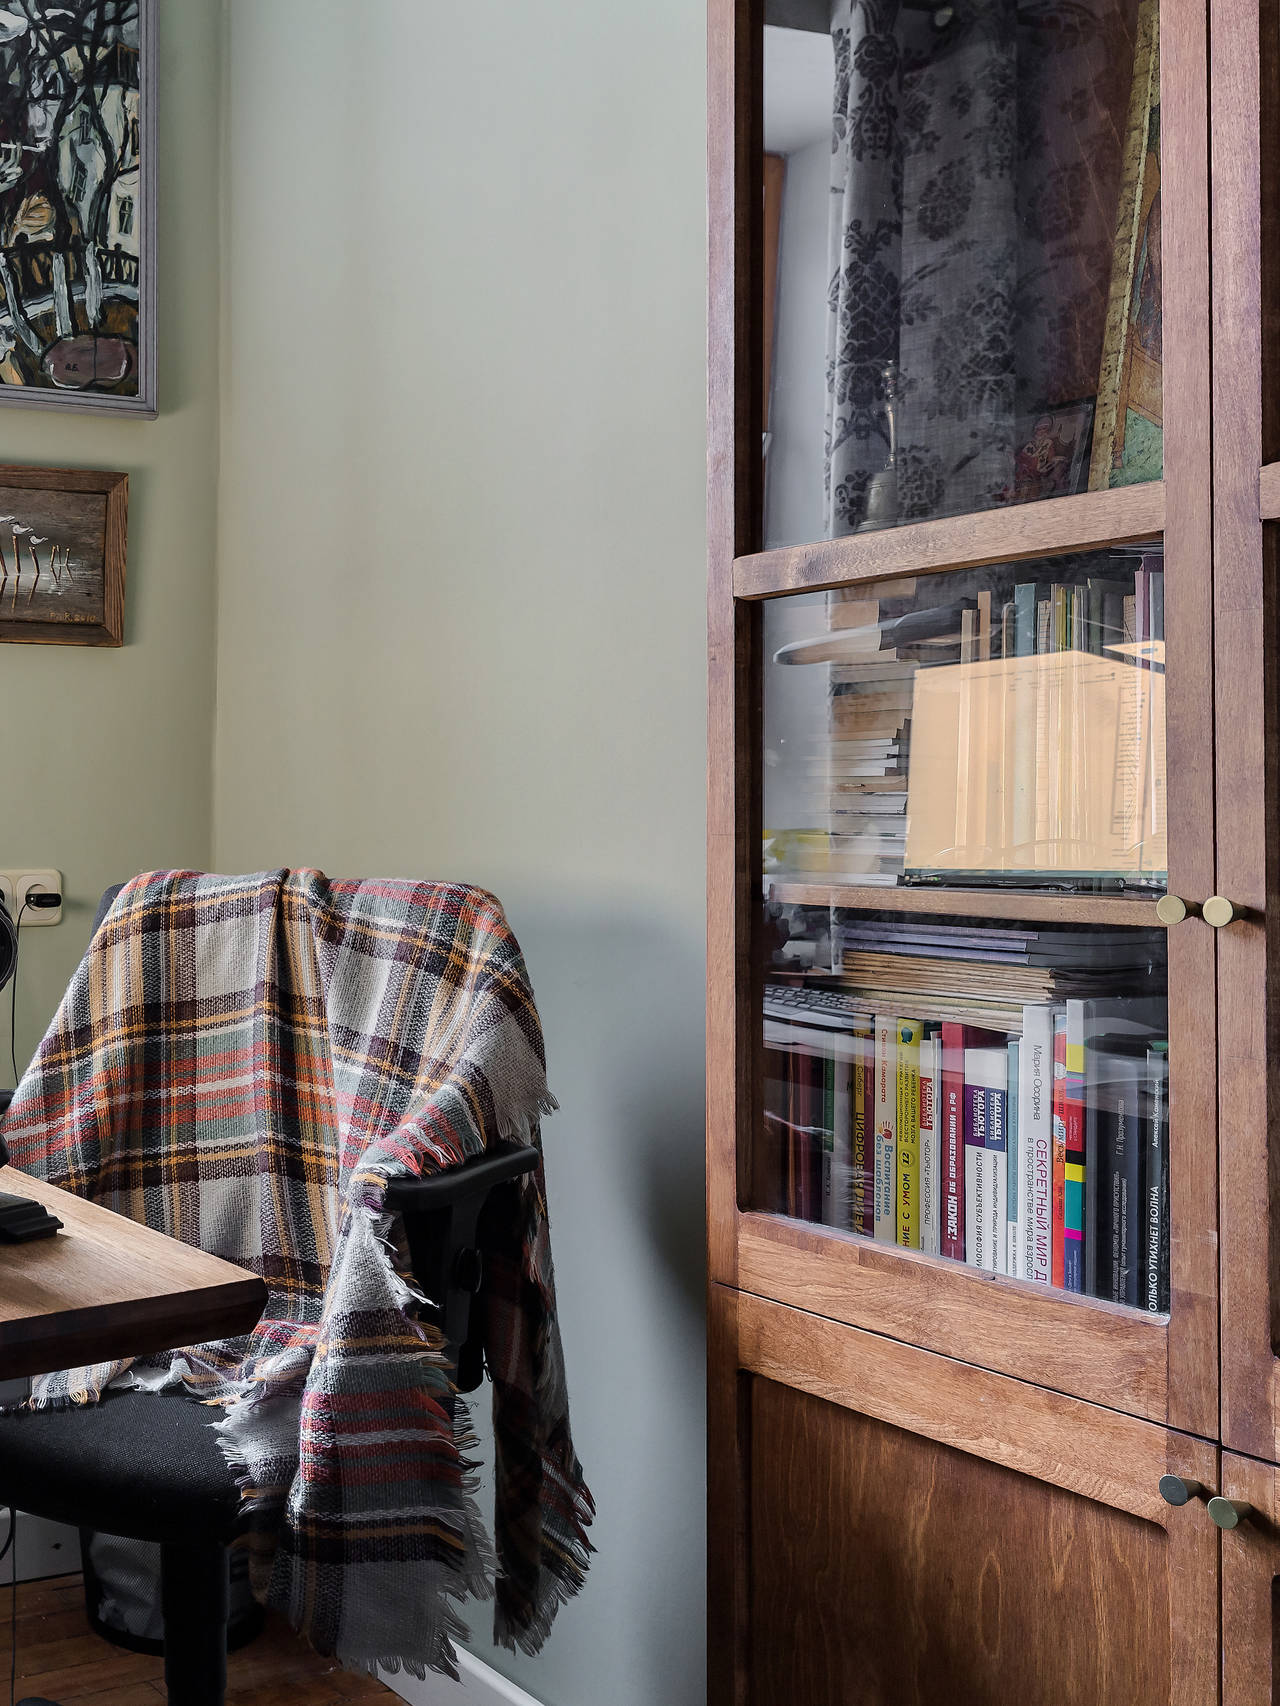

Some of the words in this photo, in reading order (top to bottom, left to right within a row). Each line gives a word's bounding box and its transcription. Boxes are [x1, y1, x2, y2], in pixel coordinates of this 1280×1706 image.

[1032, 1044, 1043, 1077] Мария
[949, 1092, 957, 1105] РФ
[1032, 1078, 1043, 1121] Осорина
[855, 1111, 865, 1190] ЦИФРОВАЯ
[876, 1135, 885, 1155] без
[949, 1114, 957, 1179] ОБРАЗОВАНИИ
[1151, 1118, 1159, 1148] Алексей
[902, 1152, 909, 1165] 12
[875, 1159, 885, 1222] шаблонов
[883, 1144, 894, 1216] Воспитание
[902, 1173, 910, 1207] УМОМ
[948, 1181, 957, 1194] ОБ
[975, 1152, 983, 1223] СУБЪЕКТИВНОСТИ
[1025, 1145, 1035, 1214] пространстве
[1036, 1139, 1051, 1231] СЕКРЕТНЫЙ
[1149, 1186, 1159, 1224] ВОЛНА
[1025, 1216, 1035, 1242] мира
[1149, 1224, 1159, 1271] УТИХНЕТ
[1036, 1234, 1048, 1267] МИР
